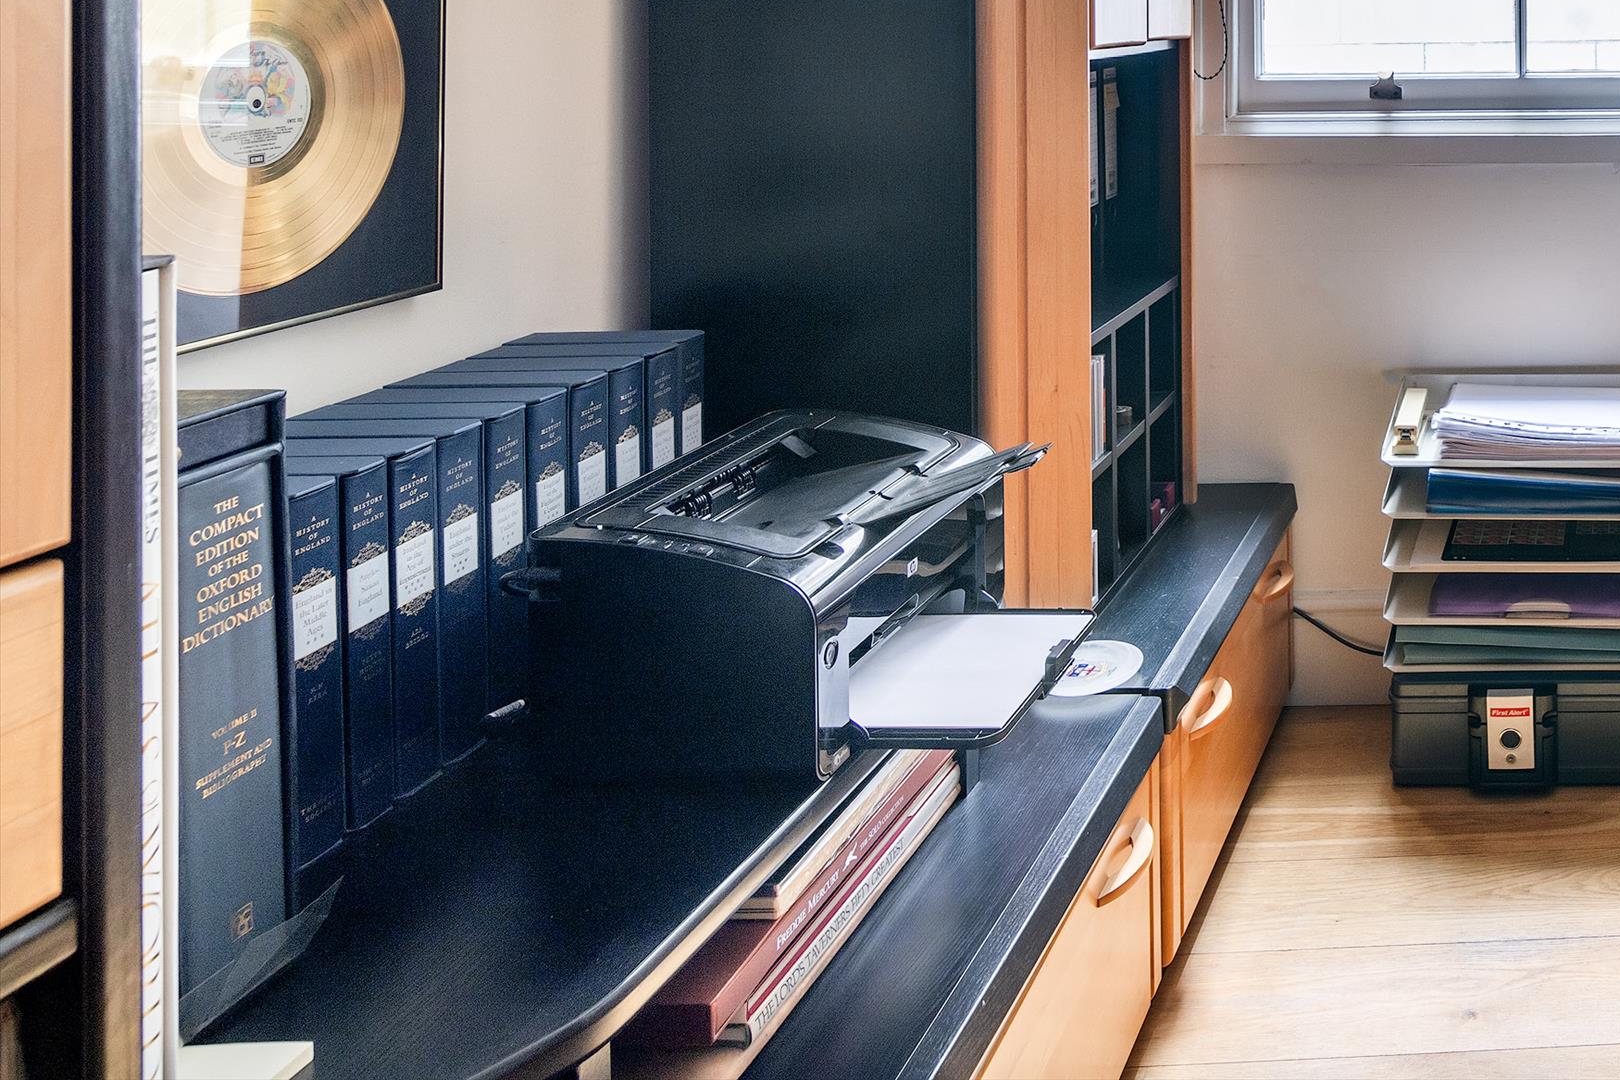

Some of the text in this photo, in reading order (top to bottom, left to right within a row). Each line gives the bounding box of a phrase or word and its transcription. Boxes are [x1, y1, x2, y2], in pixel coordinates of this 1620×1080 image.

[447, 460, 472, 475] HISTORY
[495, 454, 519, 470] ENGLAND
[400, 476, 428, 492] HISTORY
[446, 476, 473, 492] ENGLAND
[455, 472, 463, 480] OF
[399, 492, 429, 510] ENGLAND
[409, 488, 418, 496] OF
[213, 495, 239, 515] THE
[353, 495, 383, 513] HISTORY
[363, 508, 373, 516] OF
[189, 503, 264, 546] COMPACT
[296, 518, 330, 538] HISTORY
[352, 511, 384, 531] ENGLAND
[195, 526, 259, 567] EDITION
[295, 535, 331, 556] ENGLAND
[308, 532, 318, 541] OF
[208, 550, 249, 577] OF THE
[196, 563, 263, 603] OXFORD
[198, 582, 263, 624] ENGLISH
[182, 595, 275, 654] DICTIONARY
[1509, 708, 1527, 716] Alert
[755, 999, 776, 1031] THE
[805, 903, 851, 968] TAVERNERS
[851, 881, 870, 907] FIFTY
[871, 837, 905, 886] GREATEST
[775, 909, 807, 953] FREDDIE
